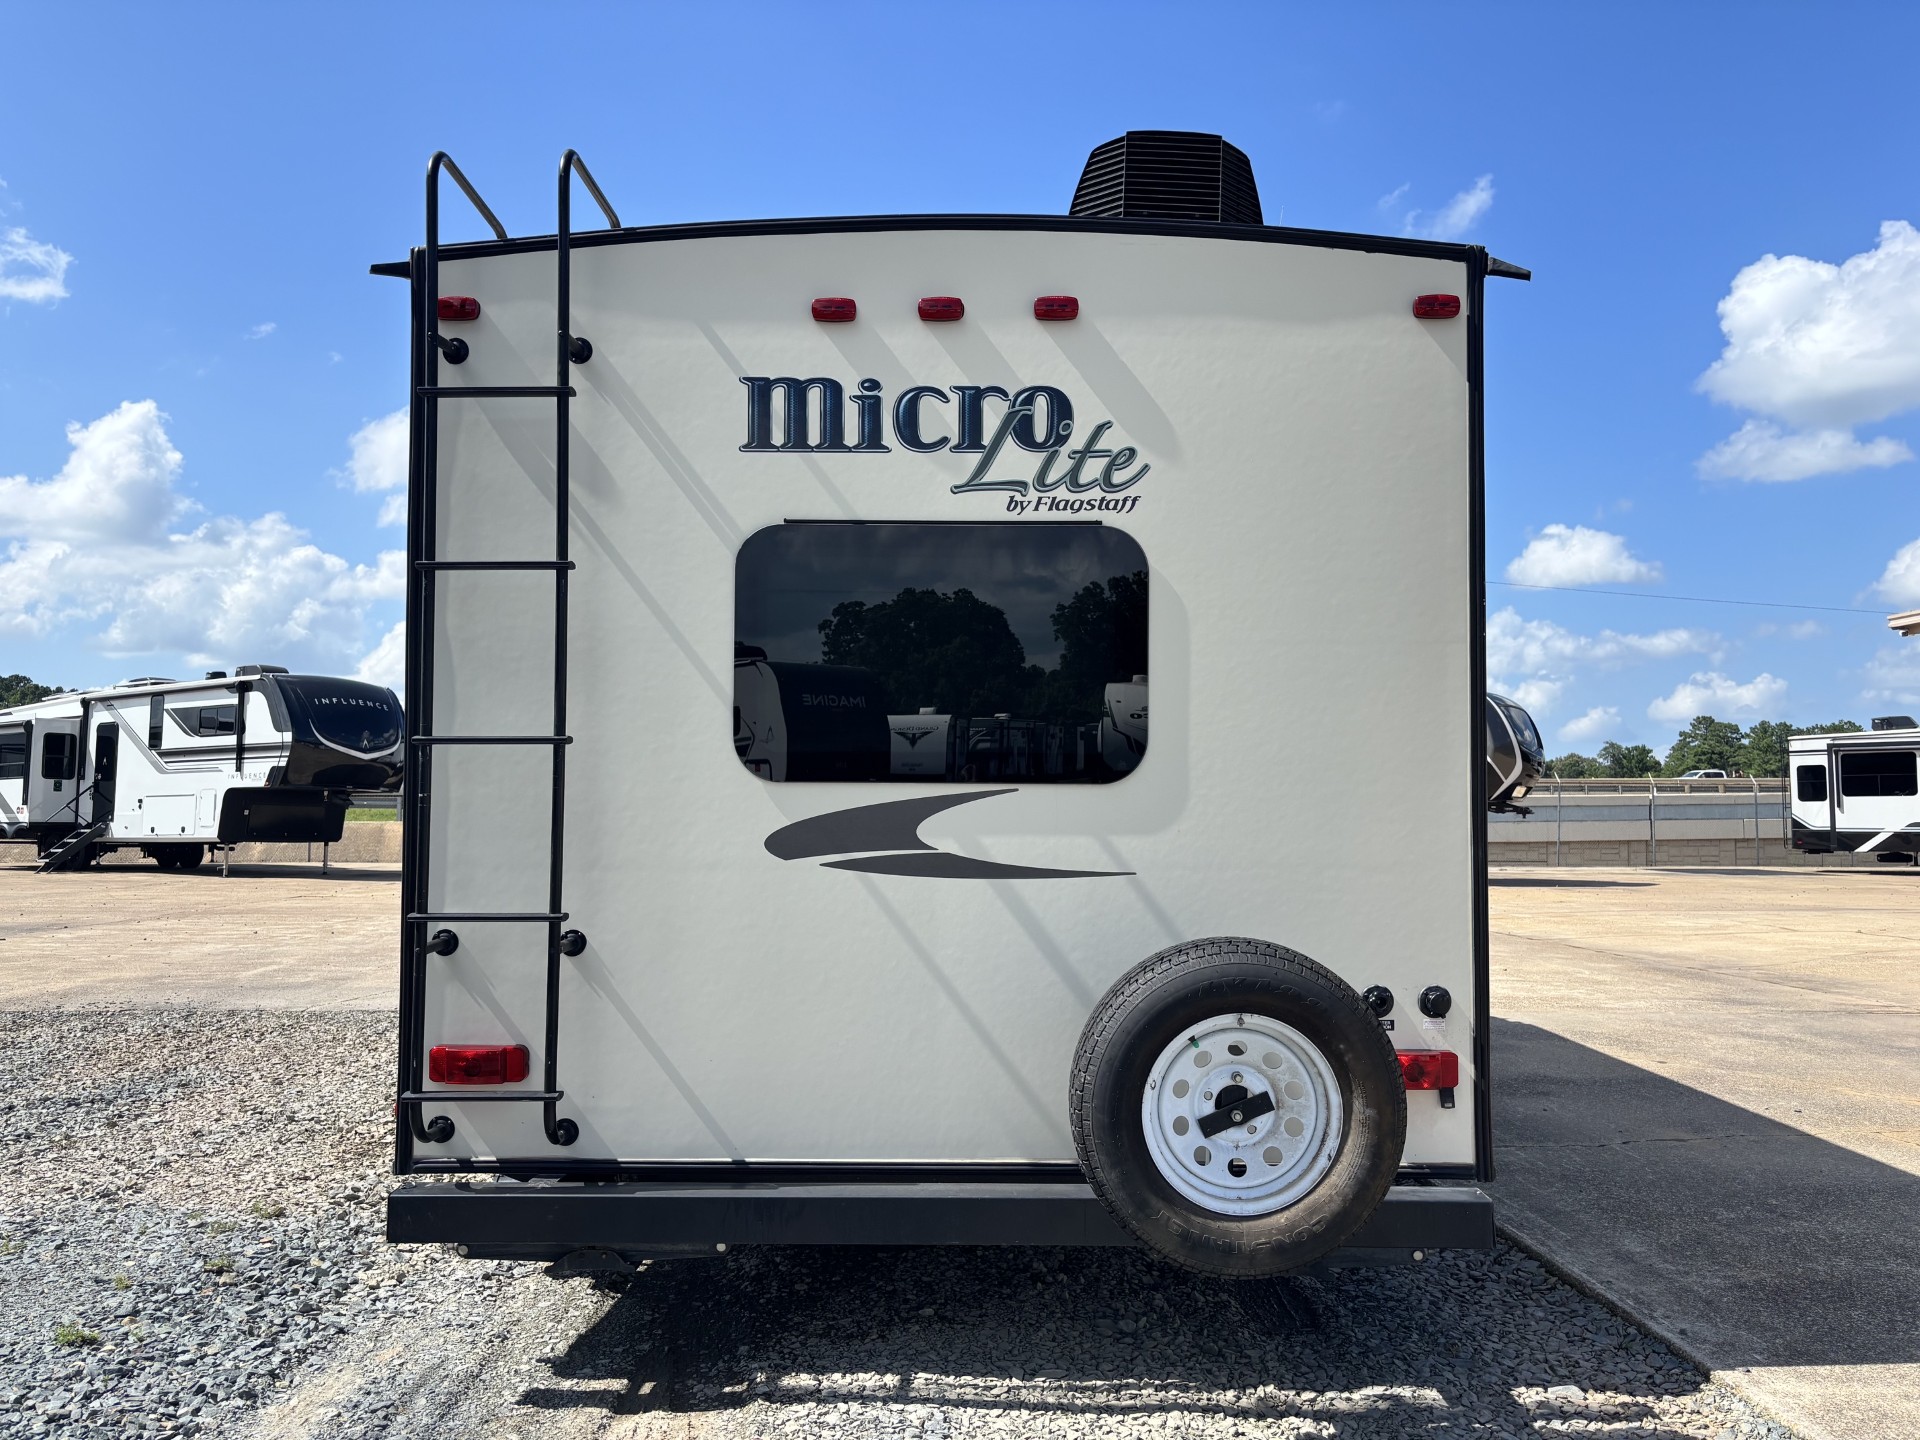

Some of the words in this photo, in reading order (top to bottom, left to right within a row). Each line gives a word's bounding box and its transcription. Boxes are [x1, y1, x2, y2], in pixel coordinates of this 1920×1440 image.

[738, 376, 1074, 453] micro
[950, 405, 1151, 496] Lite
[1006, 495, 1032, 515] by
[1032, 495, 1142, 514] Flagstaff
[314, 697, 389, 712] INFLUENCE
[227, 772, 267, 780] INFUENCE
